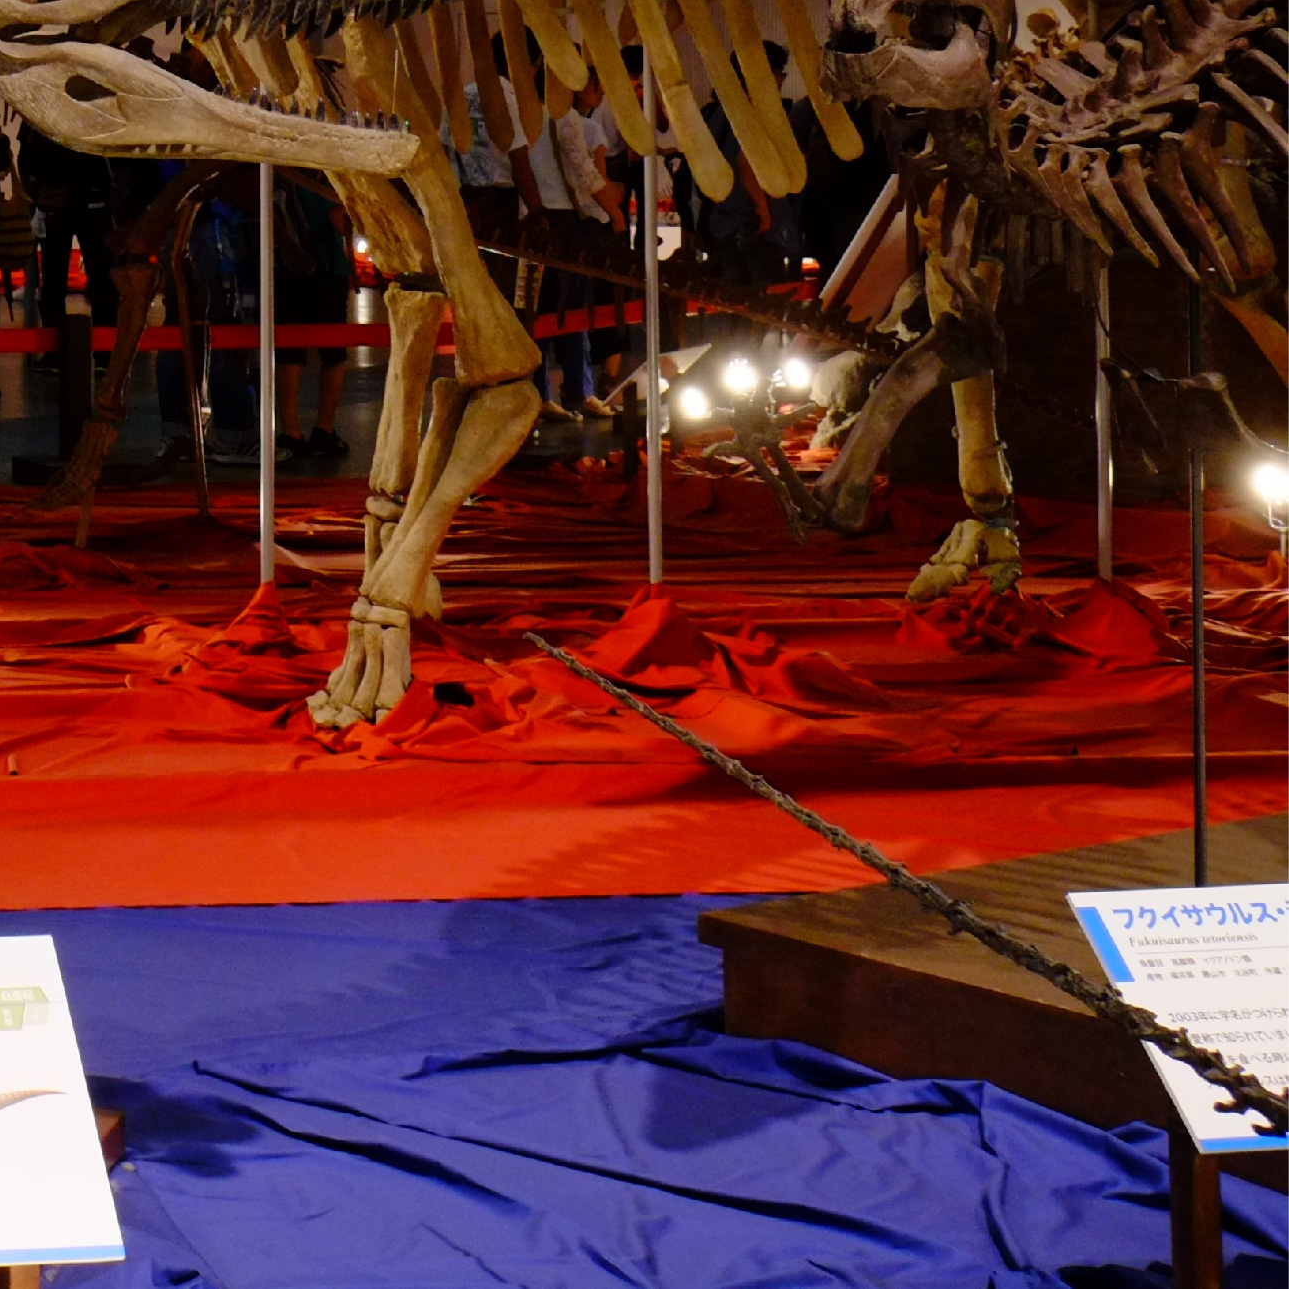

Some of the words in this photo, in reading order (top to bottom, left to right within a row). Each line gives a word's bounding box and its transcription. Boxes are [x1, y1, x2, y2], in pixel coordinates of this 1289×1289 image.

[1112, 900, 1289, 929] フクイサウルス・
[1128, 935, 1200, 948] Fukuisaurus
